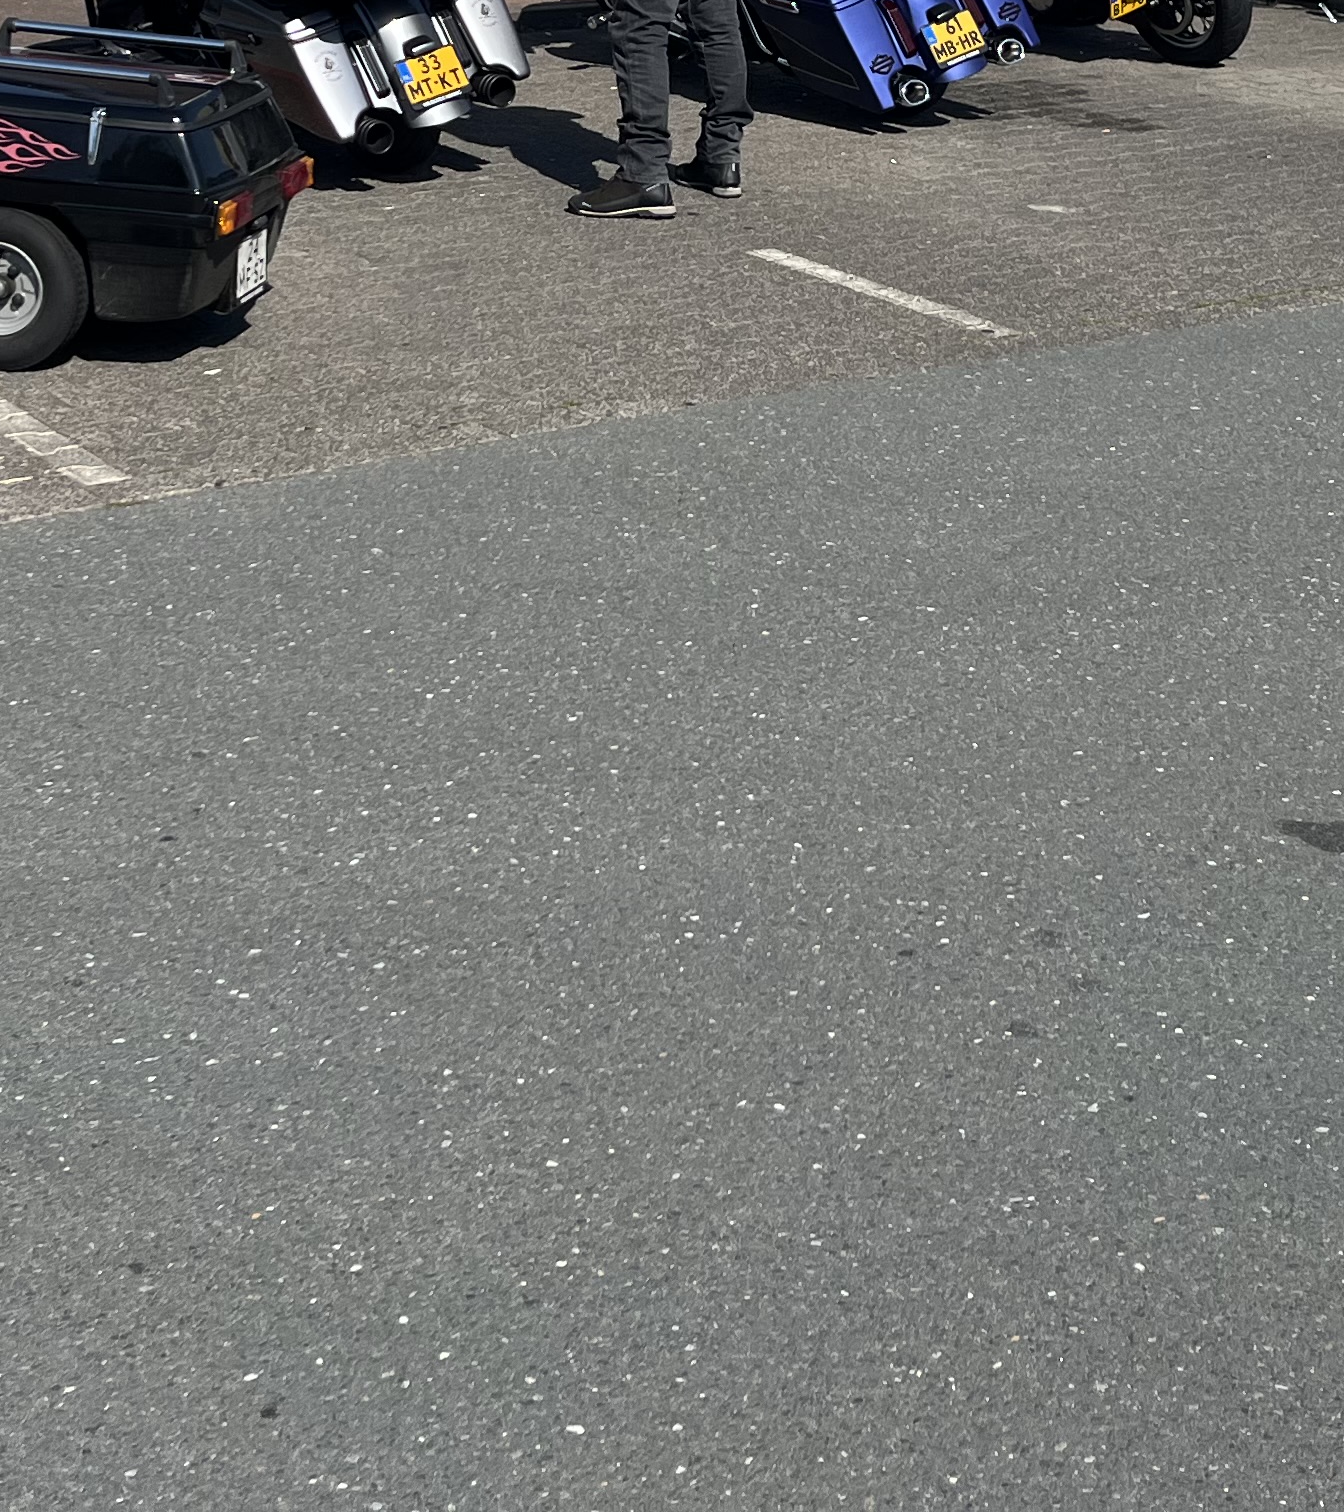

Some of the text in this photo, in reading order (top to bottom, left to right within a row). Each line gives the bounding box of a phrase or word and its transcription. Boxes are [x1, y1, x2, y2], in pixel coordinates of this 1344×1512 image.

[946, 17, 963, 35] 61
[933, 30, 982, 61] MB-HR
[417, 53, 441, 74] 33
[407, 67, 460, 100] MT-KT
